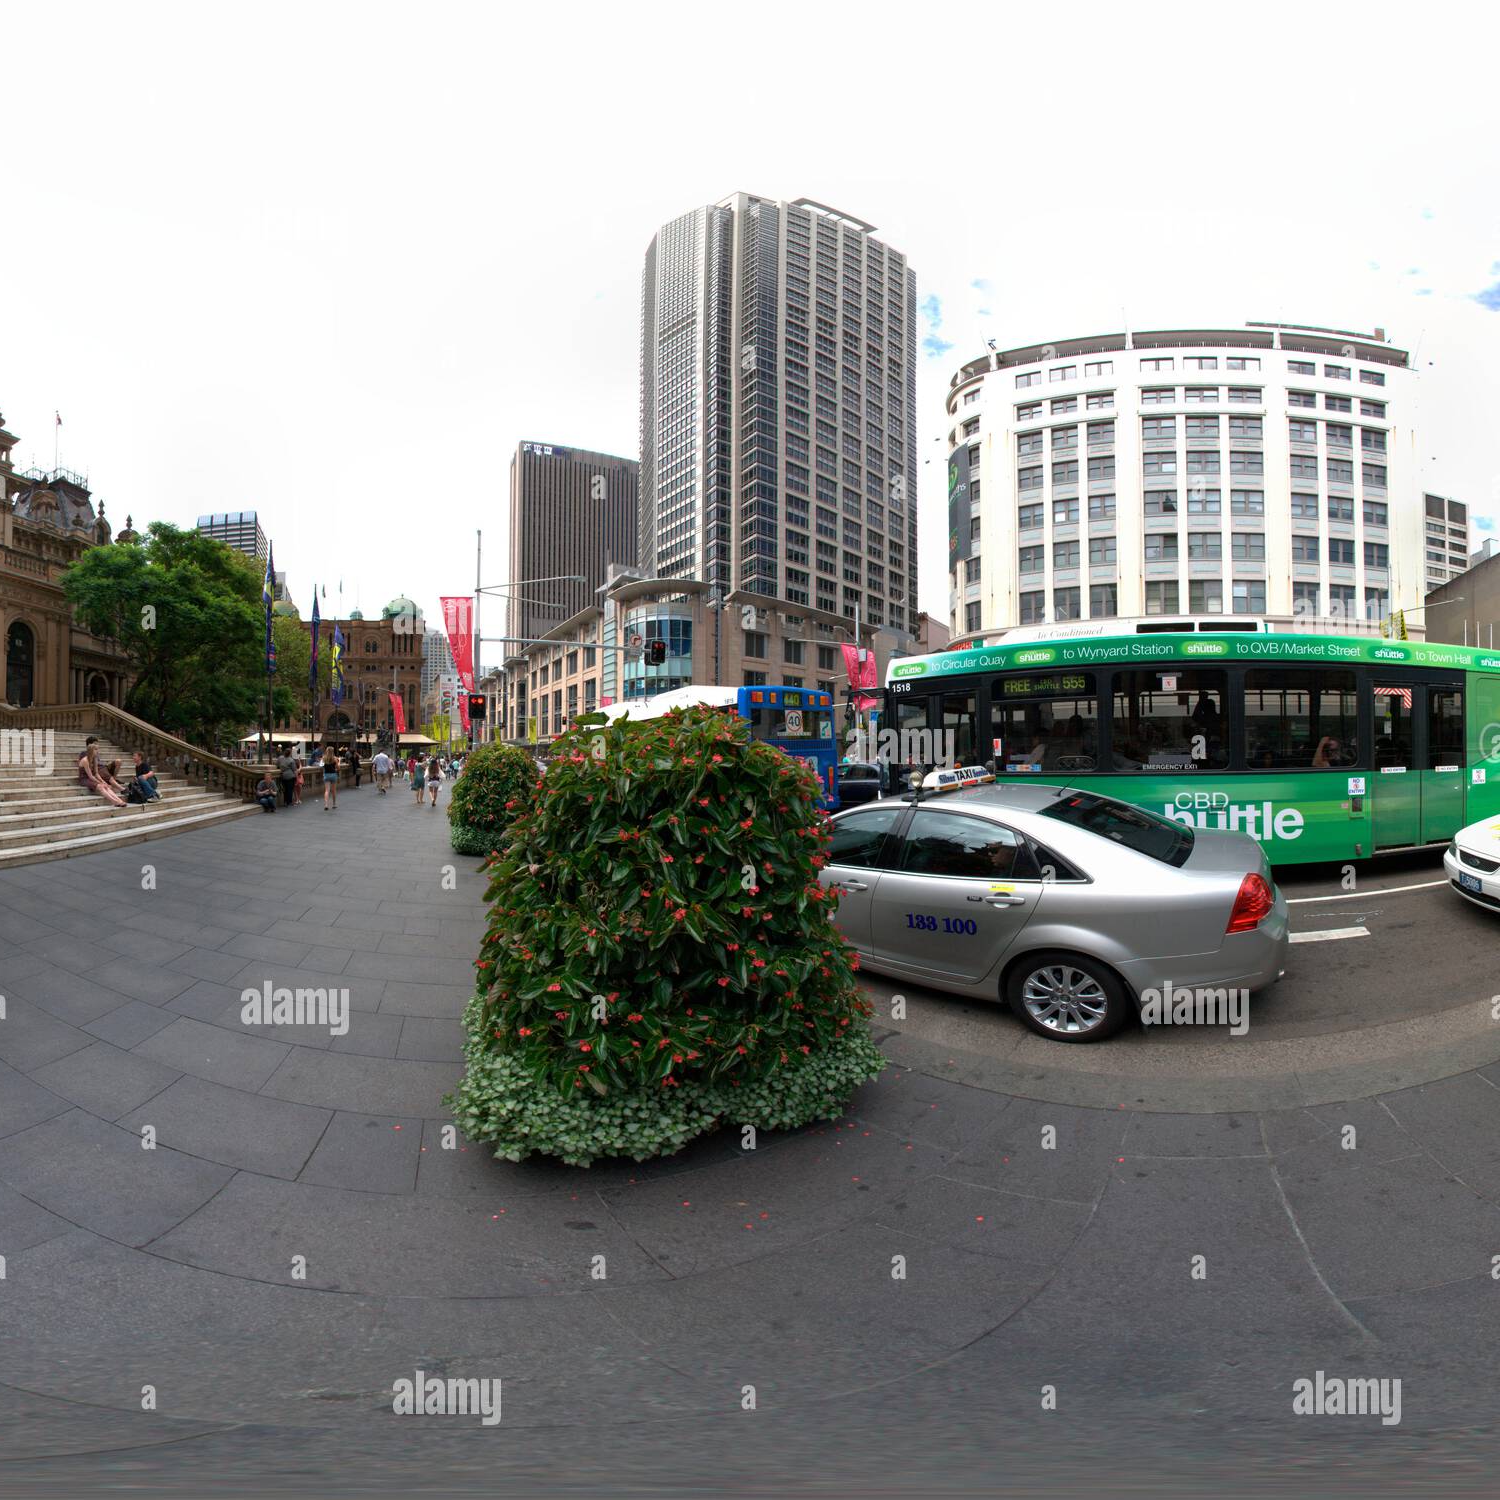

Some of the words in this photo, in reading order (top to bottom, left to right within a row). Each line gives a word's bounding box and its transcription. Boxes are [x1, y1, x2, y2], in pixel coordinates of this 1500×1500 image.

[1020, 651, 1050, 662] shuttle
[1063, 648, 1074, 659] to
[1077, 644, 1128, 660] Wynyard
[1131, 643, 1173, 656] Station
[1187, 642, 1222, 653] shuttle
[1236, 642, 1248, 653] to
[1328, 644, 1361, 656] Street
[1375, 649, 1404, 659] shuttle
[1416, 651, 1425, 661] to
[1426, 651, 1452, 662] Town
[1455, 653, 1471, 664] Hall
[931, 662, 940, 671] to
[942, 658, 977, 669] Circular
[980, 655, 1006, 666] Quay
[892, 683, 911, 693] 1518
[1004, 680, 1031, 693] FREE
[1063, 676, 1085, 689] 555
[788, 715, 800, 727] 40
[954, 768, 973, 780] TAXI
[1175, 792, 1229, 809] CBD
[1164, 802, 1304, 841] huttle
[905, 912, 938, 931] 133
[942, 917, 978, 935] 100
